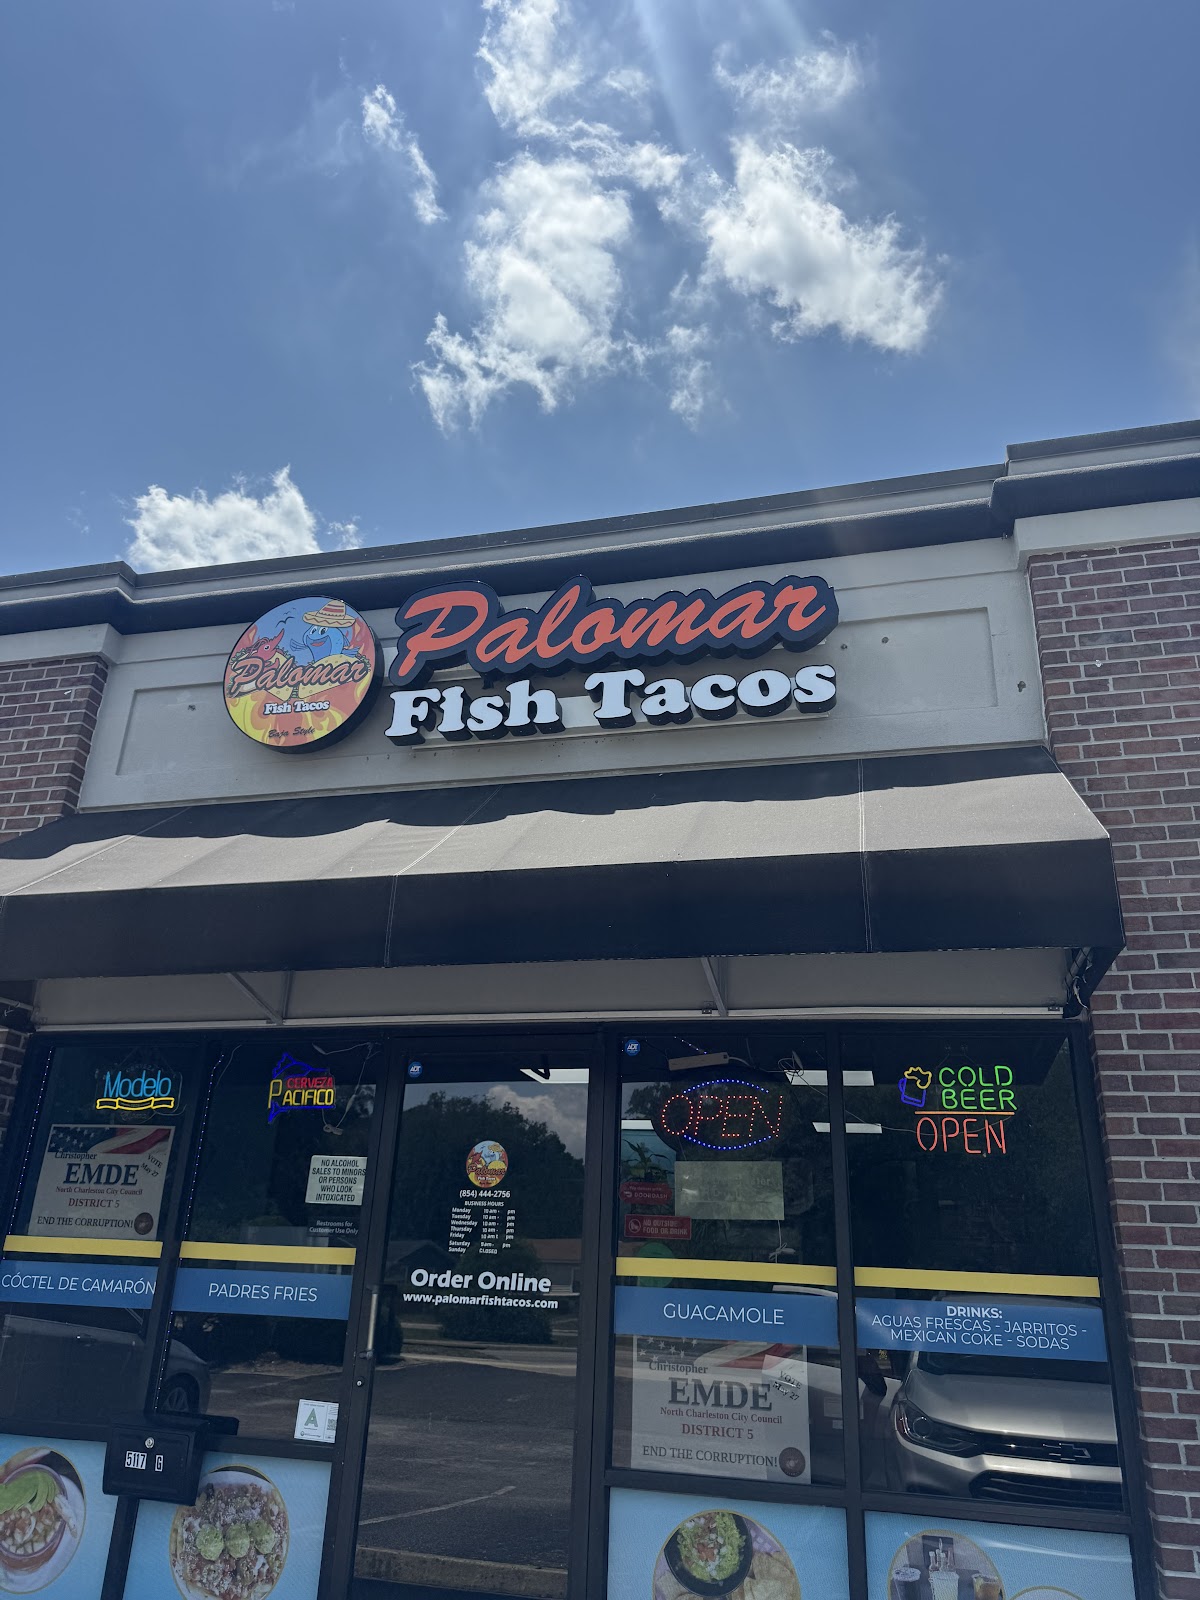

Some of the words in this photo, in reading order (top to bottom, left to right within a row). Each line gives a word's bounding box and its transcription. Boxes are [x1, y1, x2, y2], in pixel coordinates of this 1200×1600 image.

[397, 582, 829, 679] Palomar
[228, 655, 369, 696] Palomar
[263, 703, 292, 715] Fish
[293, 700, 330, 712] Tacos
[384, 679, 560, 739] Fish
[584, 664, 837, 721] Tacos
[268, 729, 288, 738] Baja
[292, 726, 316, 736] Style
[103, 1069, 172, 1098] Modelo
[287, 1076, 334, 1089] CERVEZA
[938, 1065, 1013, 1088] COLD
[267, 1079, 334, 1109] PACIFICO
[941, 1088, 1018, 1111] BEER
[661, 1093, 784, 1138] OPEN
[916, 1117, 1007, 1154] OPEN
[54, 1152, 98, 1162] Christopher
[148, 1154, 163, 1168] VOTE
[320, 1158, 330, 1167] NO
[331, 1160, 360, 1168] ALCOHOL
[62, 1162, 140, 1186] EMDE
[140, 1162, 152, 1174] May
[332, 1168, 340, 1176] TO
[342, 1168, 366, 1176] MINORS
[320, 1184, 336, 1192] WHO
[336, 1185, 354, 1193] LOOK
[328, 1176, 358, 1184] PERSONS
[74, 1186, 105, 1194] Charleston
[106, 1187, 119, 1196] City
[316, 1194, 356, 1202] INTOXICATED
[460, 1190, 478, 1198] (854)
[478, 1190, 510, 1198] 444-2756
[68, 1198, 114, 1208] DISTRICT
[114, 1200, 120, 1208] 5
[37, 1216, 56, 1226] END
[56, 1216, 74, 1226] THE
[74, 1218, 134, 1228] CORRUPTION!
[2, 1272, 55, 1290] CÓCTEL
[58, 1276, 80, 1291] DE
[82, 1278, 156, 1294] CAMARÓN
[410, 1268, 474, 1290] Order
[478, 1271, 552, 1292] Online
[208, 1282, 270, 1301] PADRES
[273, 1284, 318, 1303] FRIES
[402, 1292, 558, 1310] www.palomarfishtacos.com
[662, 1302, 785, 1325] GUACAMOLE
[946, 1305, 1002, 1319] DRINKS:
[872, 1314, 922, 1328] AGUAS
[925, 1317, 992, 1332] FRESCAS
[1004, 1320, 1078, 1336] JARRITOS
[890, 1328, 957, 1344] MEXICAN
[960, 1332, 1003, 1346] COKE
[1016, 1335, 1070, 1350] SODAS
[648, 1360, 708, 1374] Christopher
[780, 1370, 802, 1390] VOTE
[668, 1376, 773, 1412] EMDE
[772, 1381, 790, 1396] May
[790, 1391, 800, 1400] 27
[304, 1408, 318, 1428] A
[660, 1406, 684, 1418] North
[686, 1408, 729, 1420] Charleston
[731, 1410, 748, 1424] City
[750, 1414, 782, 1424] Council
[682, 1423, 744, 1438] DISTRICT
[747, 1428, 754, 1440] 5
[126, 1452, 146, 1468] 5117
[156, 1456, 162, 1470] G
[642, 1445, 667, 1458] END
[670, 1447, 693, 1460] THE
[696, 1450, 778, 1468] CORRUPTION!
